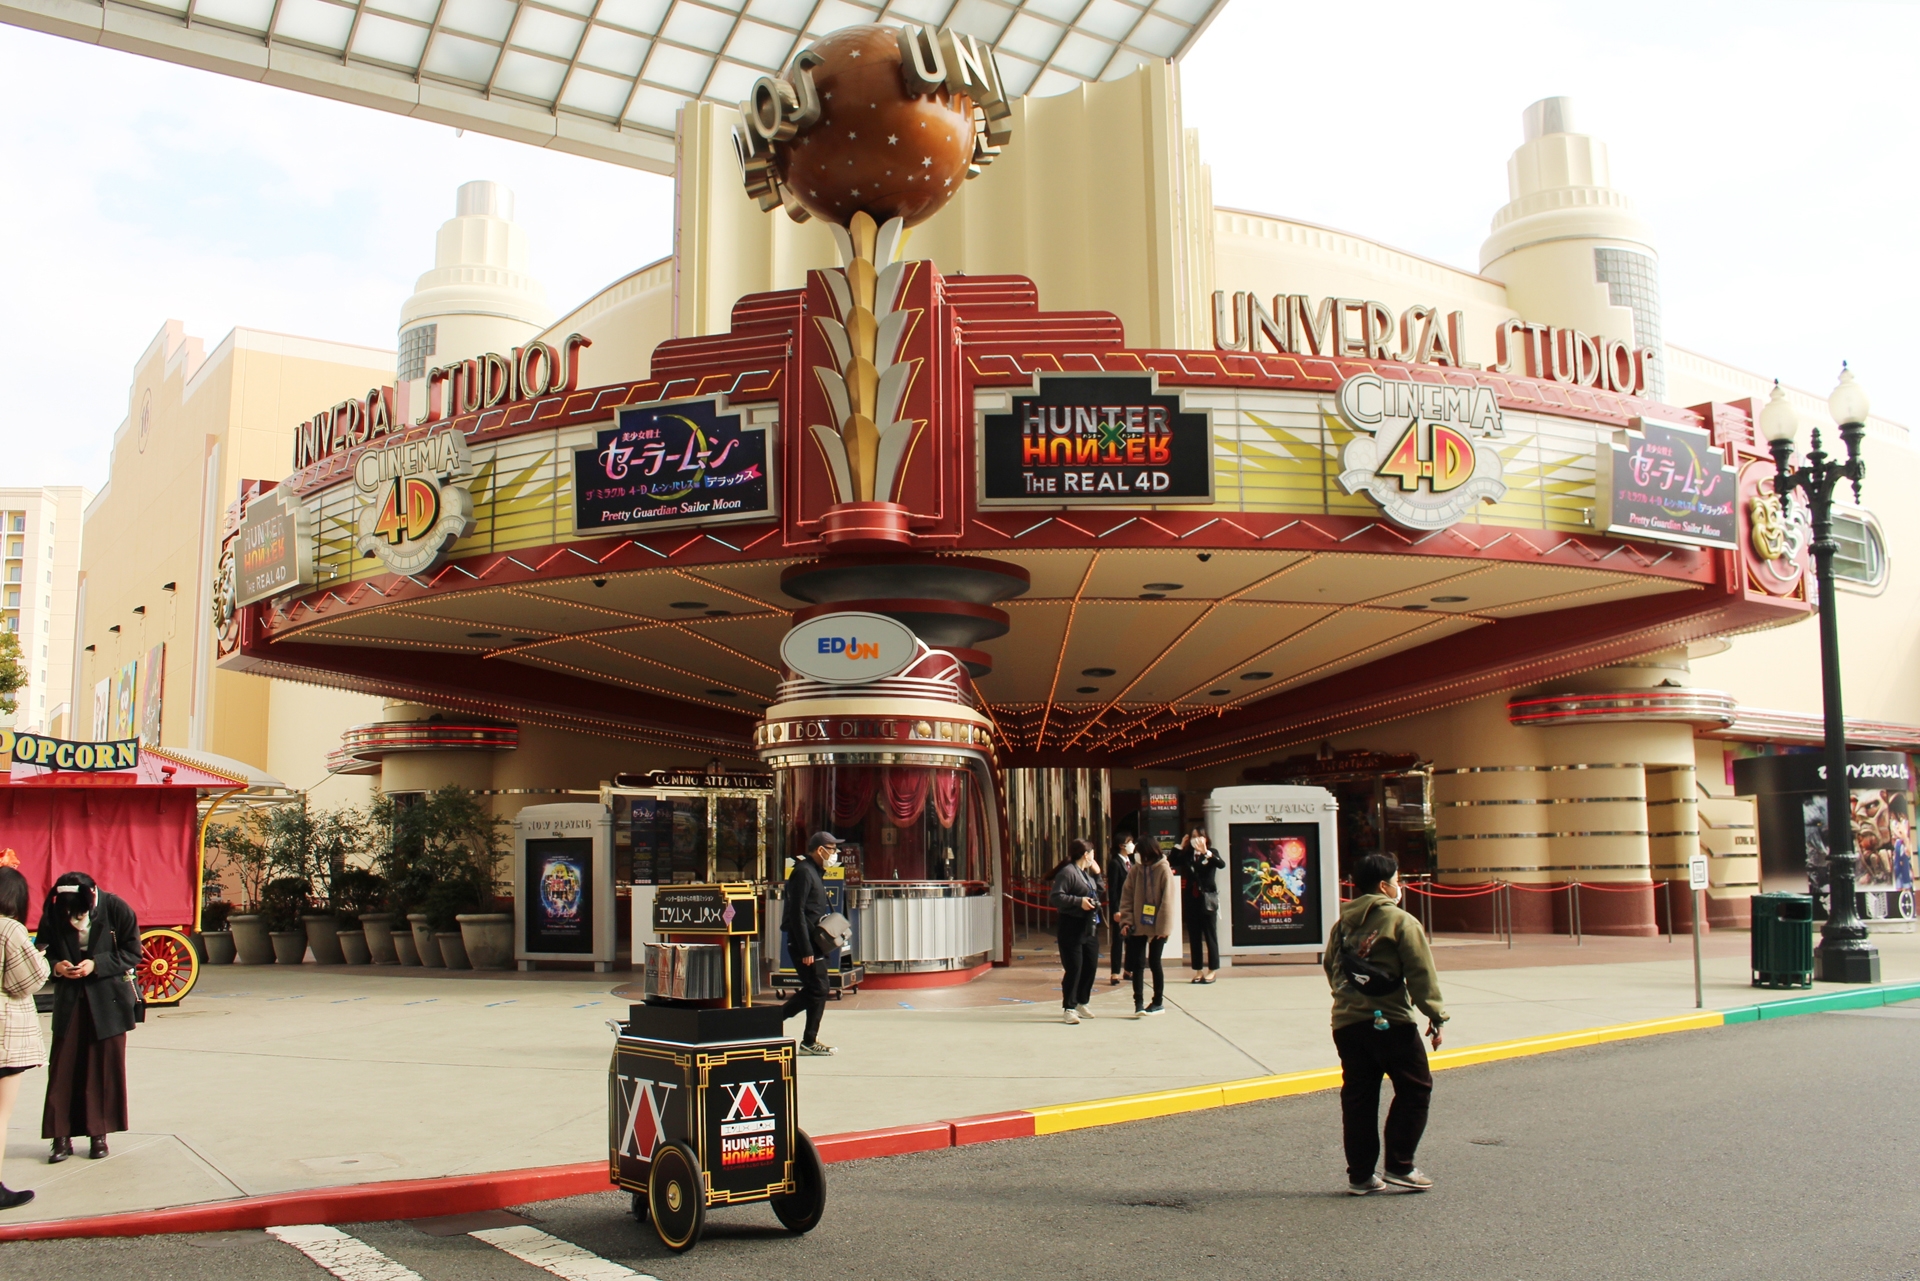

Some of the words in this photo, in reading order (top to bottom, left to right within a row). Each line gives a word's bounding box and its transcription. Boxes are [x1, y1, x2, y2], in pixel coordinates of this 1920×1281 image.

[1212, 290, 1481, 369] UNIVERSAL
[1492, 317, 1656, 398] STUDIOS
[292, 381, 405, 472] UNIVERSAL
[416, 333, 592, 426] STUDIOS
[1342, 376, 1506, 437] CINEMA
[1022, 402, 1171, 435] HUNTER
[355, 434, 460, 493] CINEMA
[598, 426, 739, 480] セーラームーン
[1376, 419, 1476, 493] 4-D
[706, 469, 754, 488] デラックス
[1064, 472, 1130, 491] REAL
[1135, 472, 1170, 491] 4D
[1629, 445, 1721, 497] セーラームーン
[373, 476, 440, 545] 4-D
[601, 510, 631, 522] Pretty
[633, 505, 677, 519] Guardian
[680, 501, 710, 514] Sailor
[712, 498, 741, 511] Moon
[244, 514, 285, 551] HUNTER
[1629, 512, 1651, 527] Pretty
[1651, 516, 1682, 531] Guardian
[1682, 521, 1702, 534] Sailor
[1702, 524, 1721, 537] Moon
[256, 570, 275, 590] REAL
[275, 565, 287, 581] 4D
[818, 637, 879, 660] EDION
[796, 722, 828, 738] BOX
[704, 775, 773, 788] ATTRACTIOS
[1230, 803, 1260, 815] NOW
[528, 820, 550, 831] NOW
[554, 819, 592, 830] PLAYING
[722, 1135, 775, 1152] HUNTER
